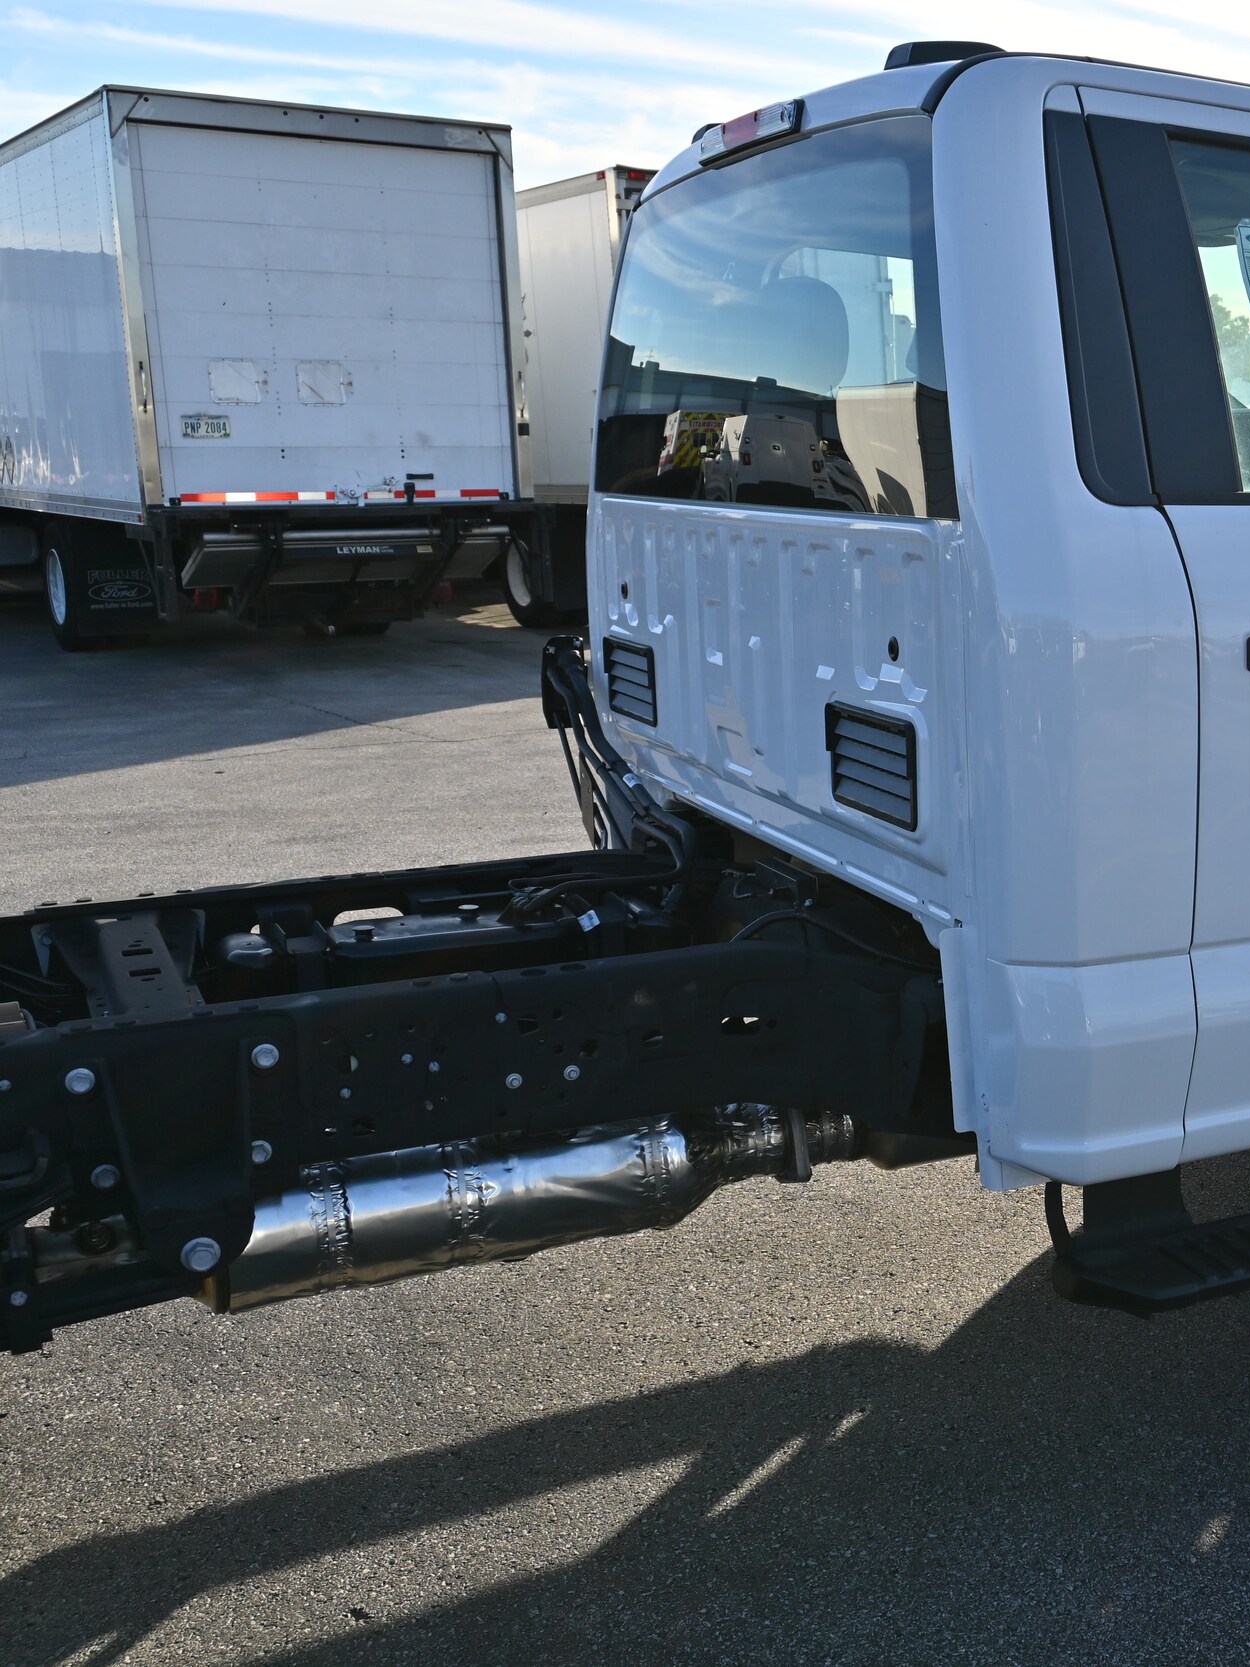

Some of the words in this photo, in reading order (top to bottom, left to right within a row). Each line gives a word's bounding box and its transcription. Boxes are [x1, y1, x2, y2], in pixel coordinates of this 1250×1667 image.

[184, 422, 201, 434] PNP
[205, 421, 227, 434] 2084
[336, 545, 380, 554] LEYMAN
[101, 585, 138, 598] Ford
